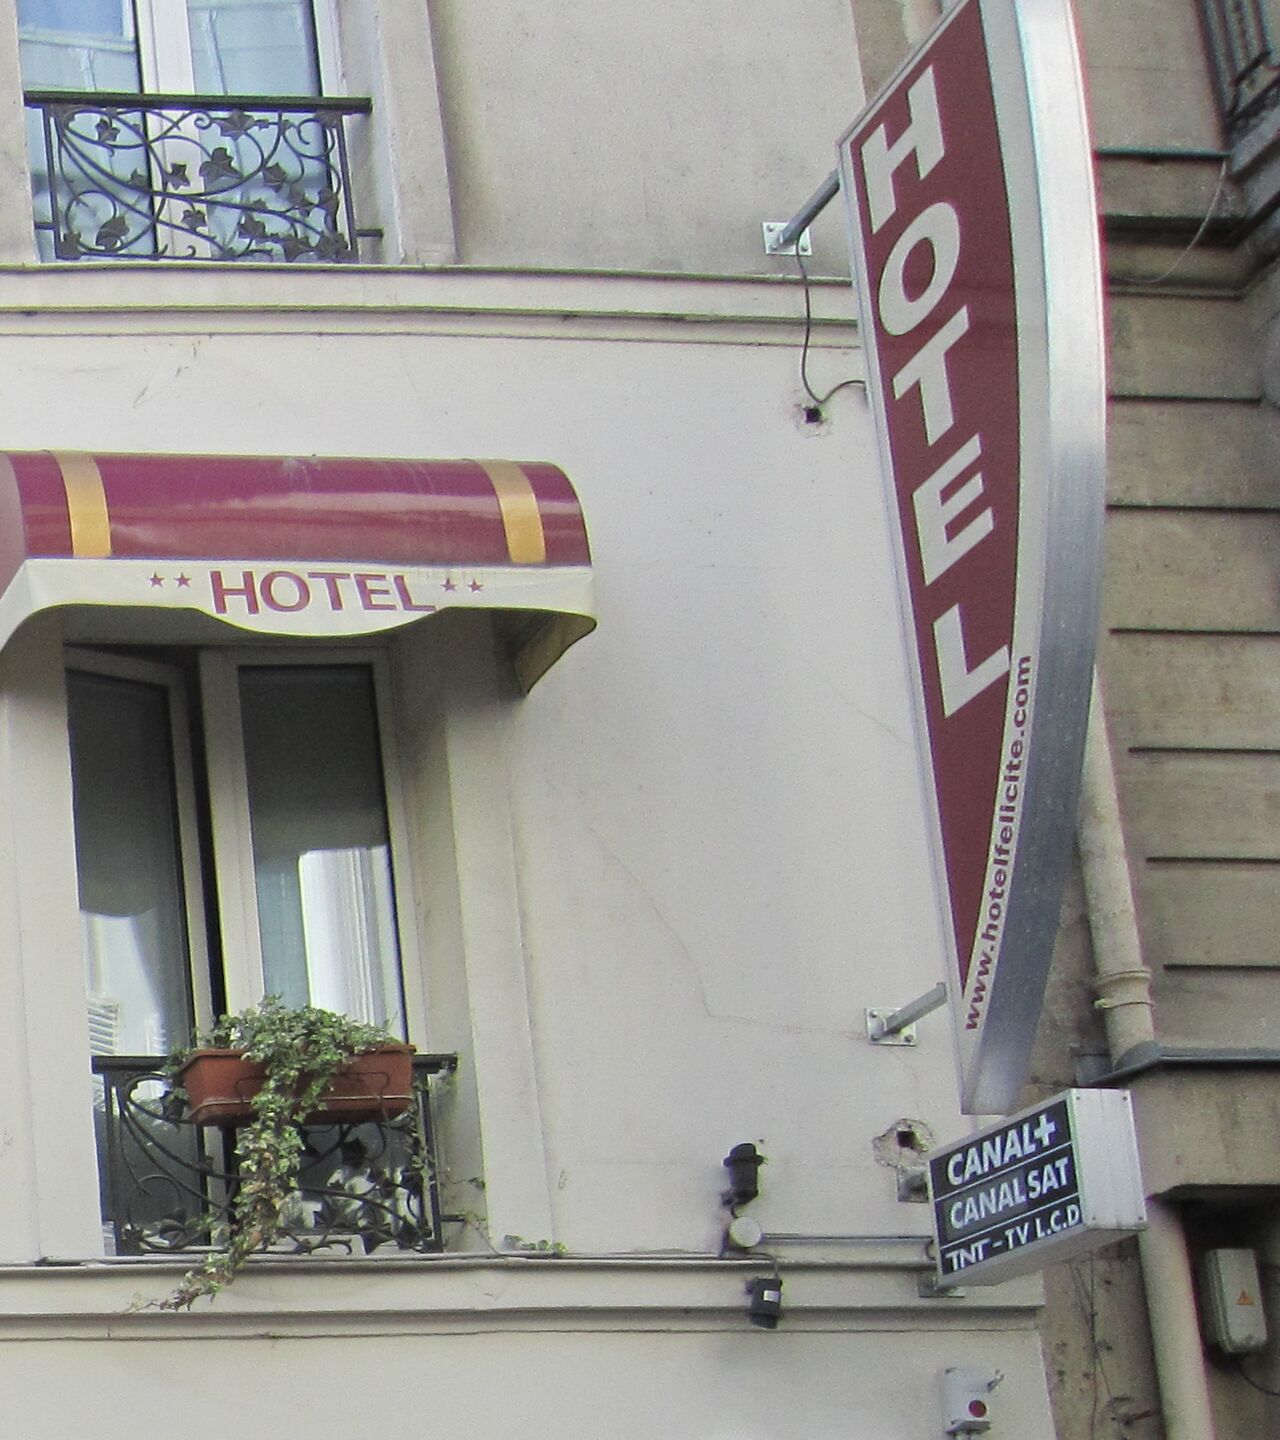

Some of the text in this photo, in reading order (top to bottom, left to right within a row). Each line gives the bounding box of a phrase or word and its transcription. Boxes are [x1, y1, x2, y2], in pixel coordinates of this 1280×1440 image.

[860, 64, 1010, 718] HOTEL
[209, 570, 437, 615] HOTEL
[966, 655, 1032, 1030] www.hotelfelicite.com
[947, 1113, 1056, 1185] CANAL+
